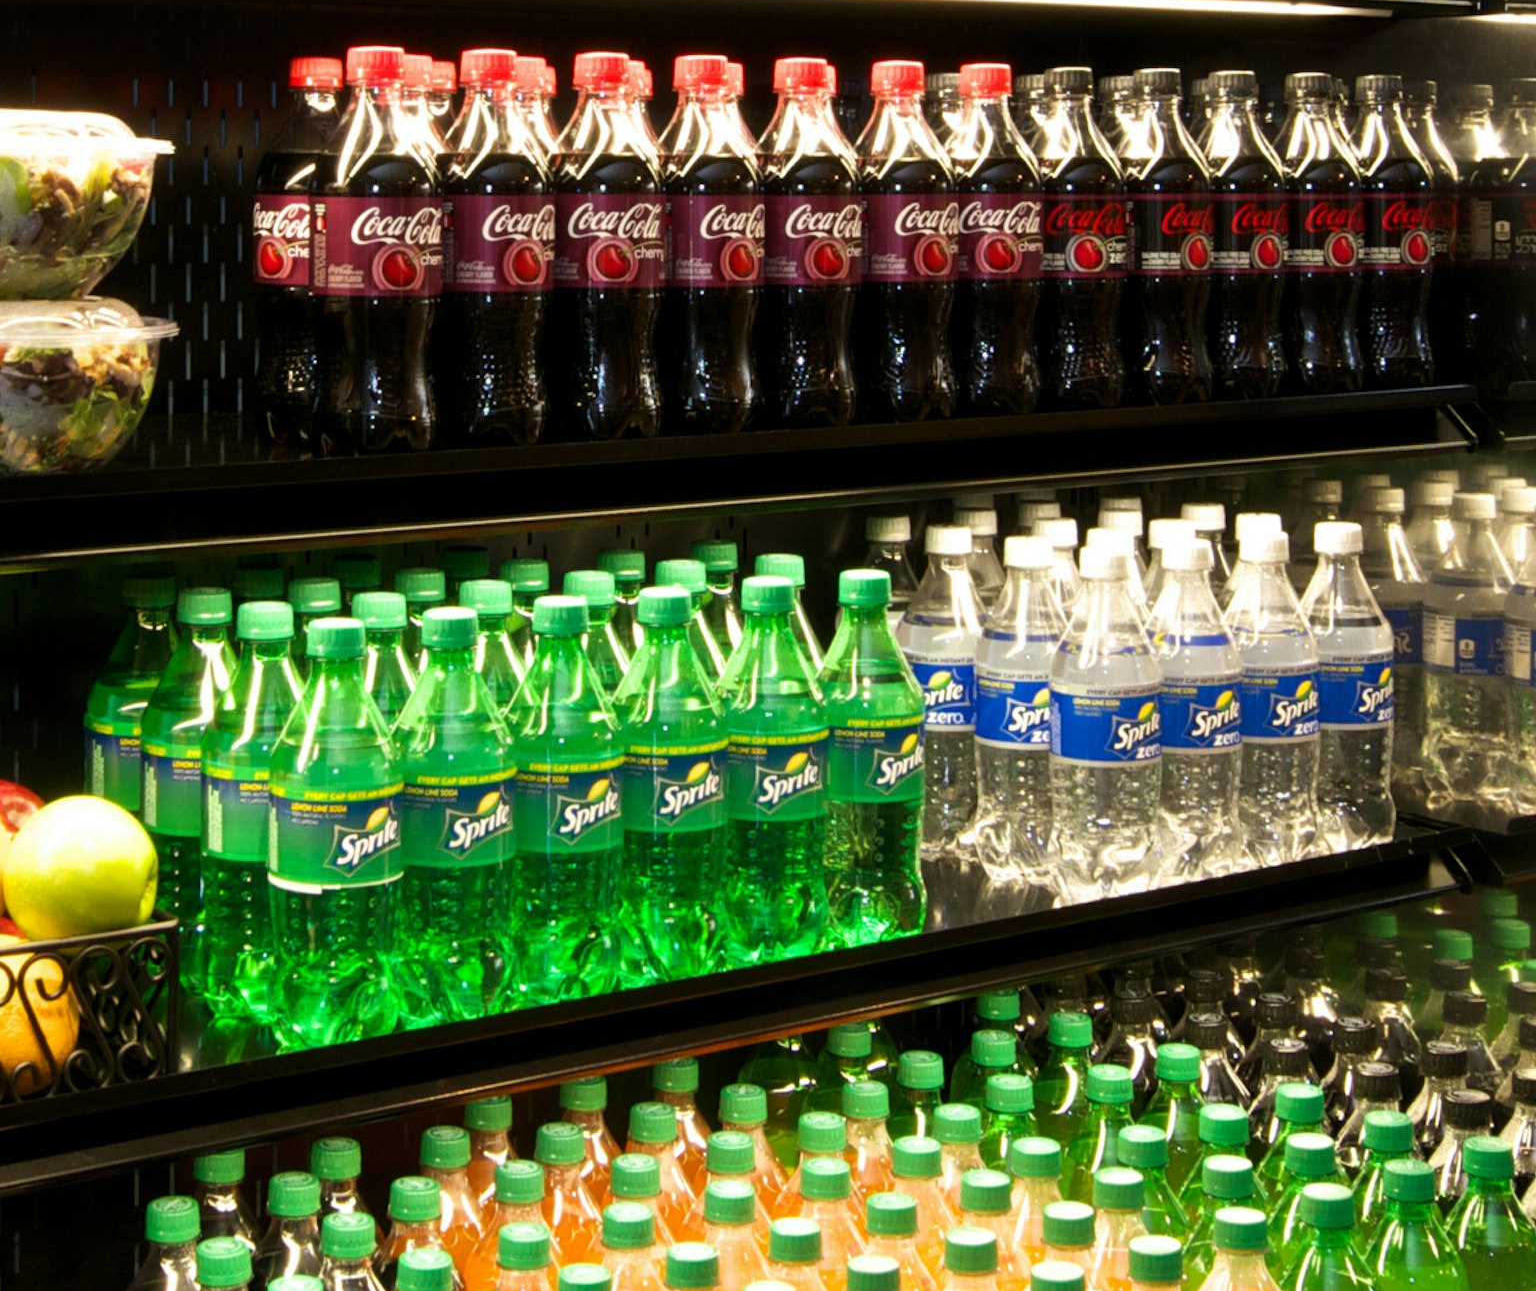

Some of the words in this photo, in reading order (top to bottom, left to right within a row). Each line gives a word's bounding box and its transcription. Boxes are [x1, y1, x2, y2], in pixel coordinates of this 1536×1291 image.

[351, 206, 442, 246] Coca-Cola
[567, 202, 662, 239] Coca-Cola
[958, 201, 1043, 235] Coca-Cola
[923, 679, 963, 706] prite
[927, 712, 964, 724] zero
[1008, 700, 1050, 734] Spri
[552, 775, 570, 784] SODA
[757, 757, 819, 806] Sprite
[877, 743, 924, 785] Sprit
[441, 788, 459, 796] SODA
[559, 786, 619, 835] Sprite
[659, 767, 720, 816] Sprite
[336, 815, 398, 866] Sprite
[449, 798, 510, 848] Sprite
